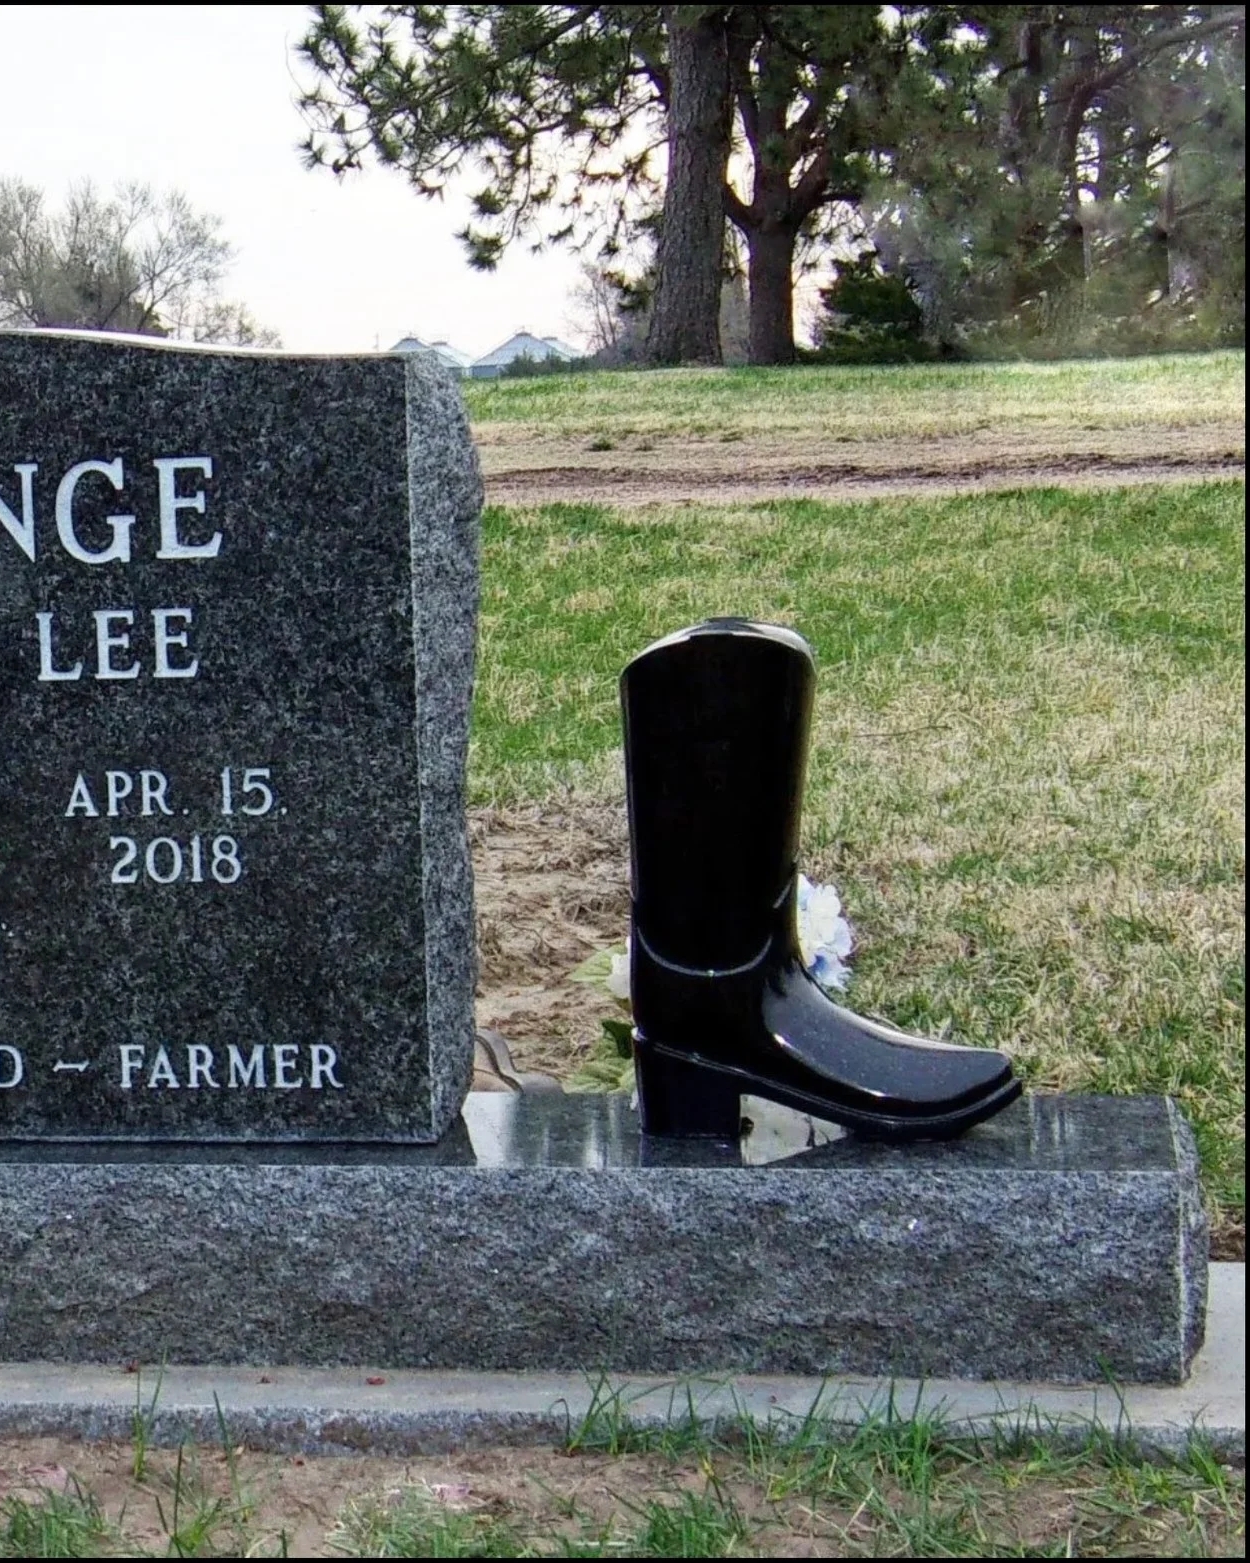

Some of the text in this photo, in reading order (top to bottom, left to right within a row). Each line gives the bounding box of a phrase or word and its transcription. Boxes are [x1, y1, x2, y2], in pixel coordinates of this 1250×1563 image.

[35, 607, 199, 681] LEE
[64, 770, 190, 817] APR.
[109, 835, 242, 884] 2018
[119, 1043, 344, 1089] FARMER
